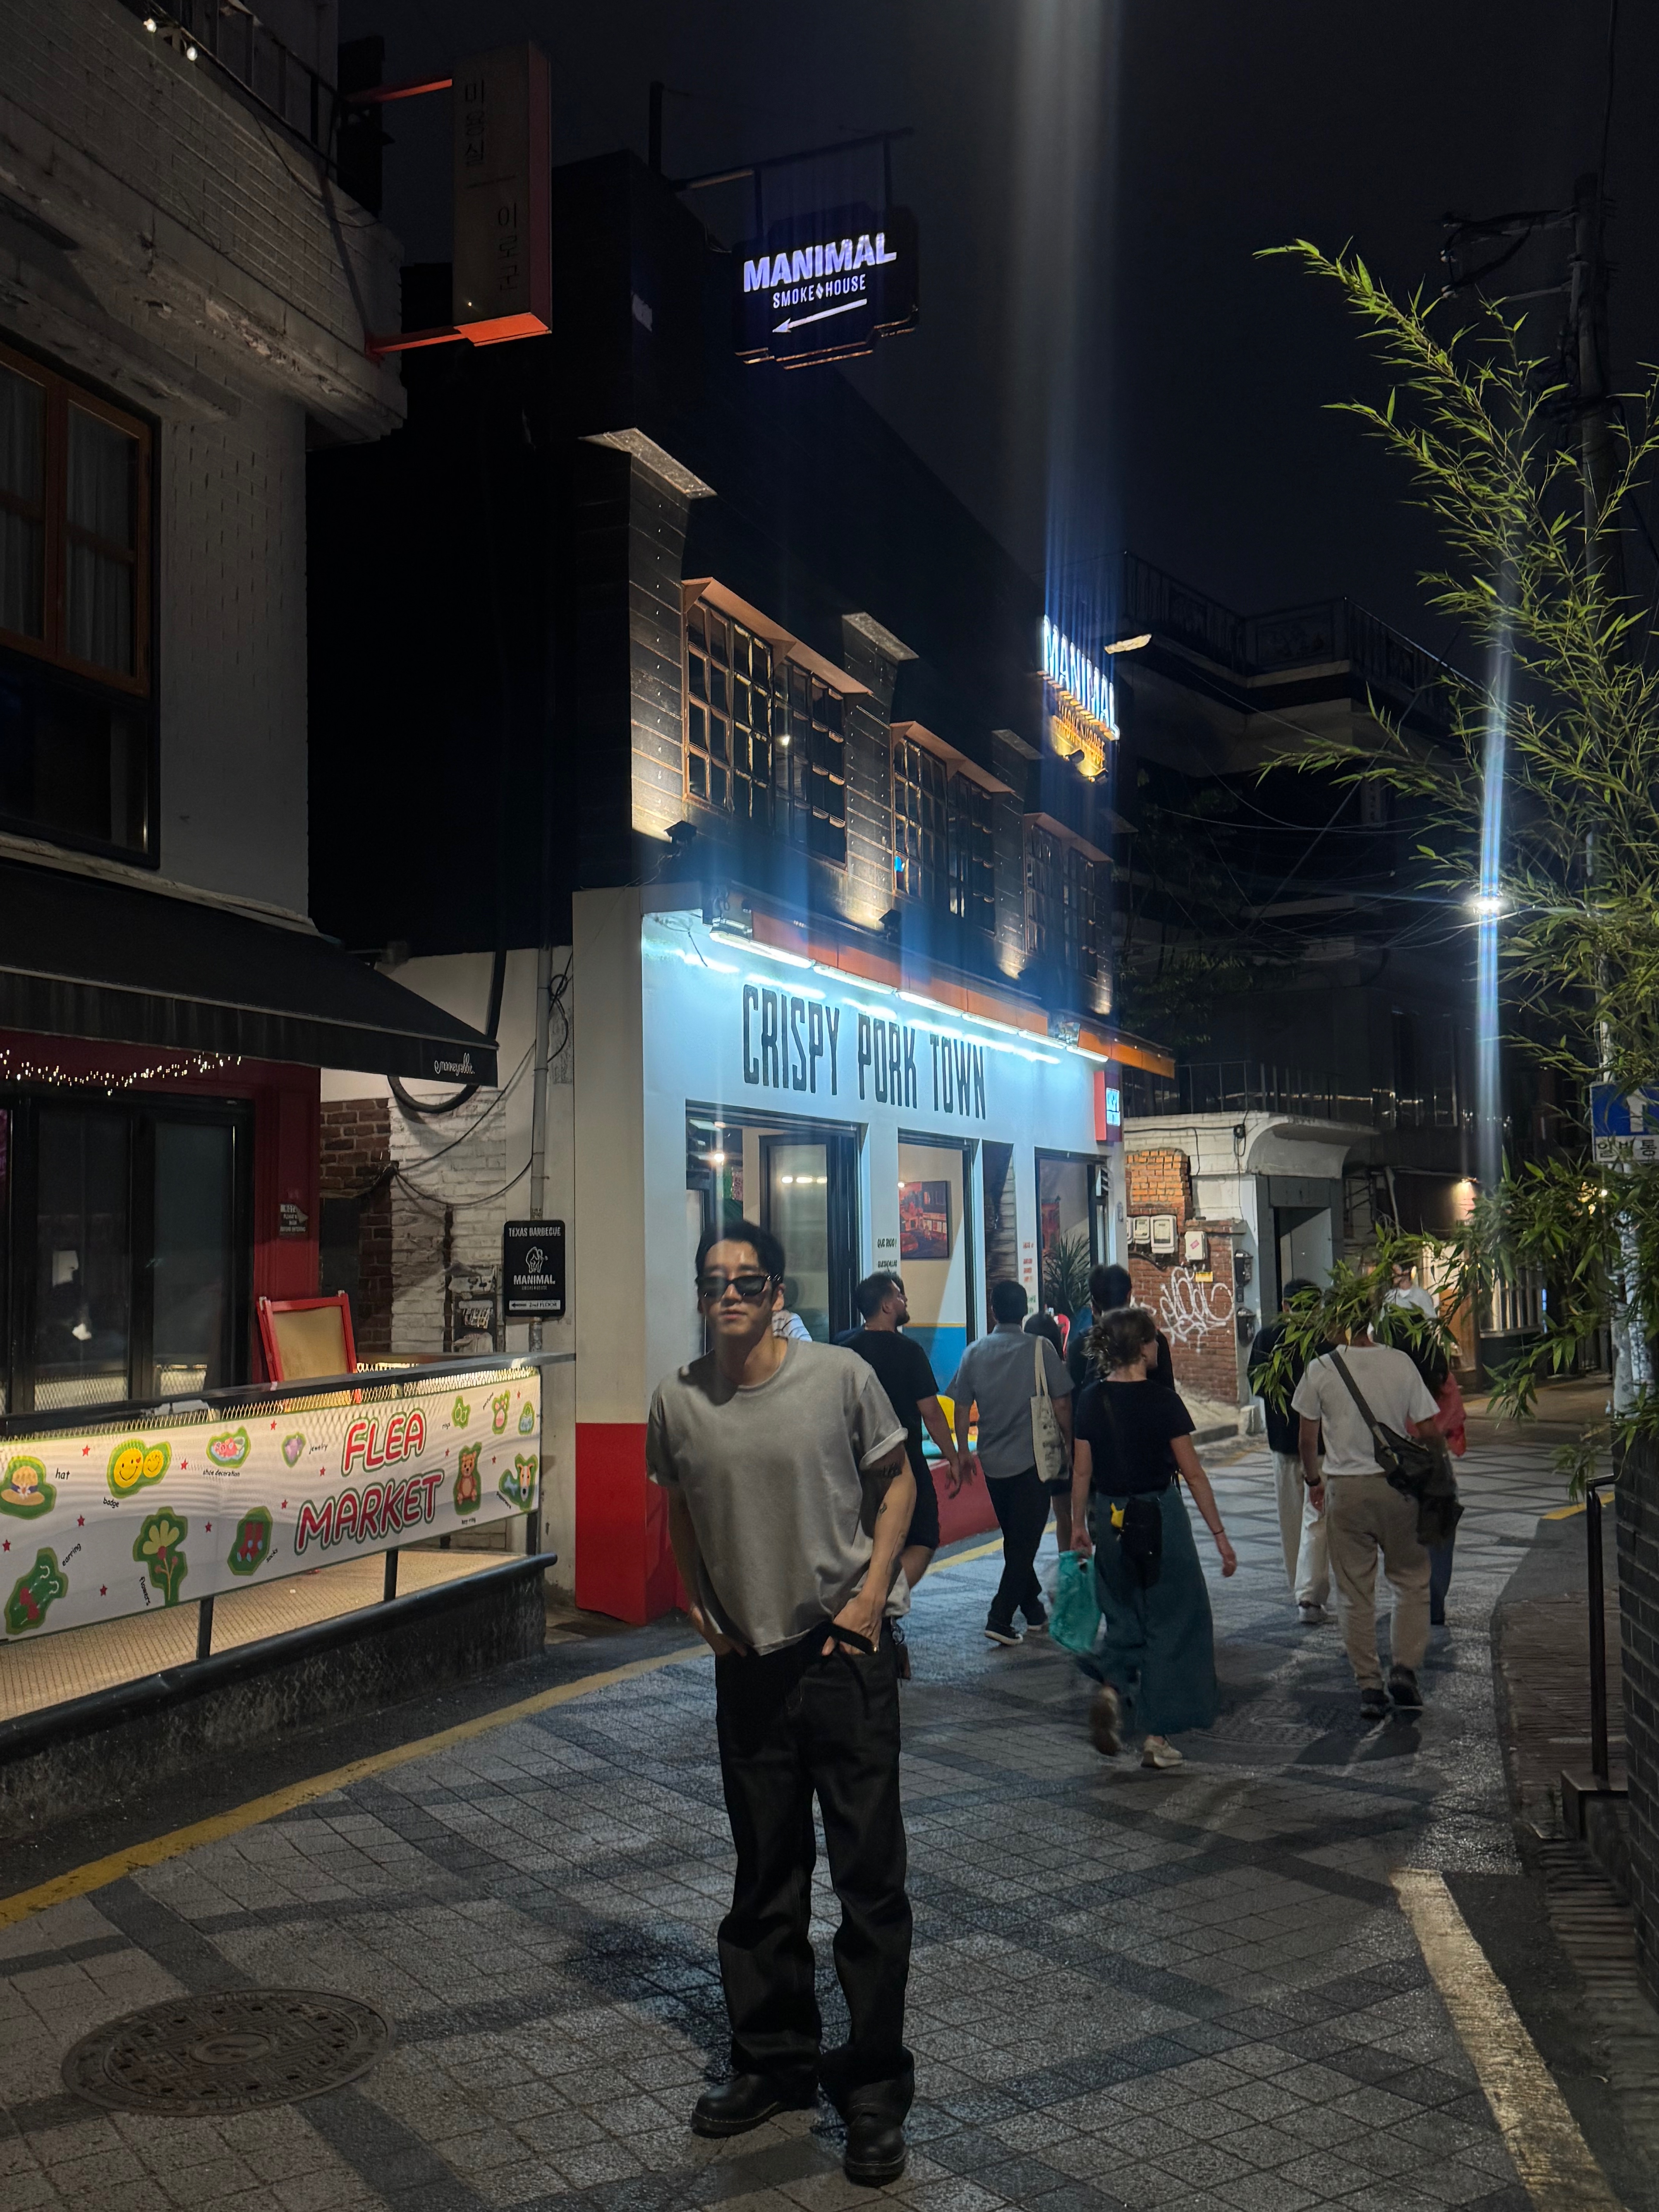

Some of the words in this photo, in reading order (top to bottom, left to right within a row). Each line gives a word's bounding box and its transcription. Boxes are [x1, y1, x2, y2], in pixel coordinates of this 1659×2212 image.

[465, 79, 485, 166] 미용실
[744, 233, 896, 292] MANIMAL
[773, 284, 814, 309] SMOKE
[826, 274, 866, 297] HOUSE
[742, 984, 840, 1096] CRISPY
[857, 1013, 917, 1109] PORK
[929, 1033, 986, 1120] TOWN
[509, 1227, 527, 1237] TEXAS
[514, 1274, 554, 1285] MANIMAL
[342, 1408, 426, 1476] FLEA
[55, 1467, 70, 1480] hat
[103, 1496, 119, 1508] badge
[295, 1469, 444, 1555] MARKET
[62, 1543, 82, 1566] earring
[139, 1576, 151, 1606] flowers
